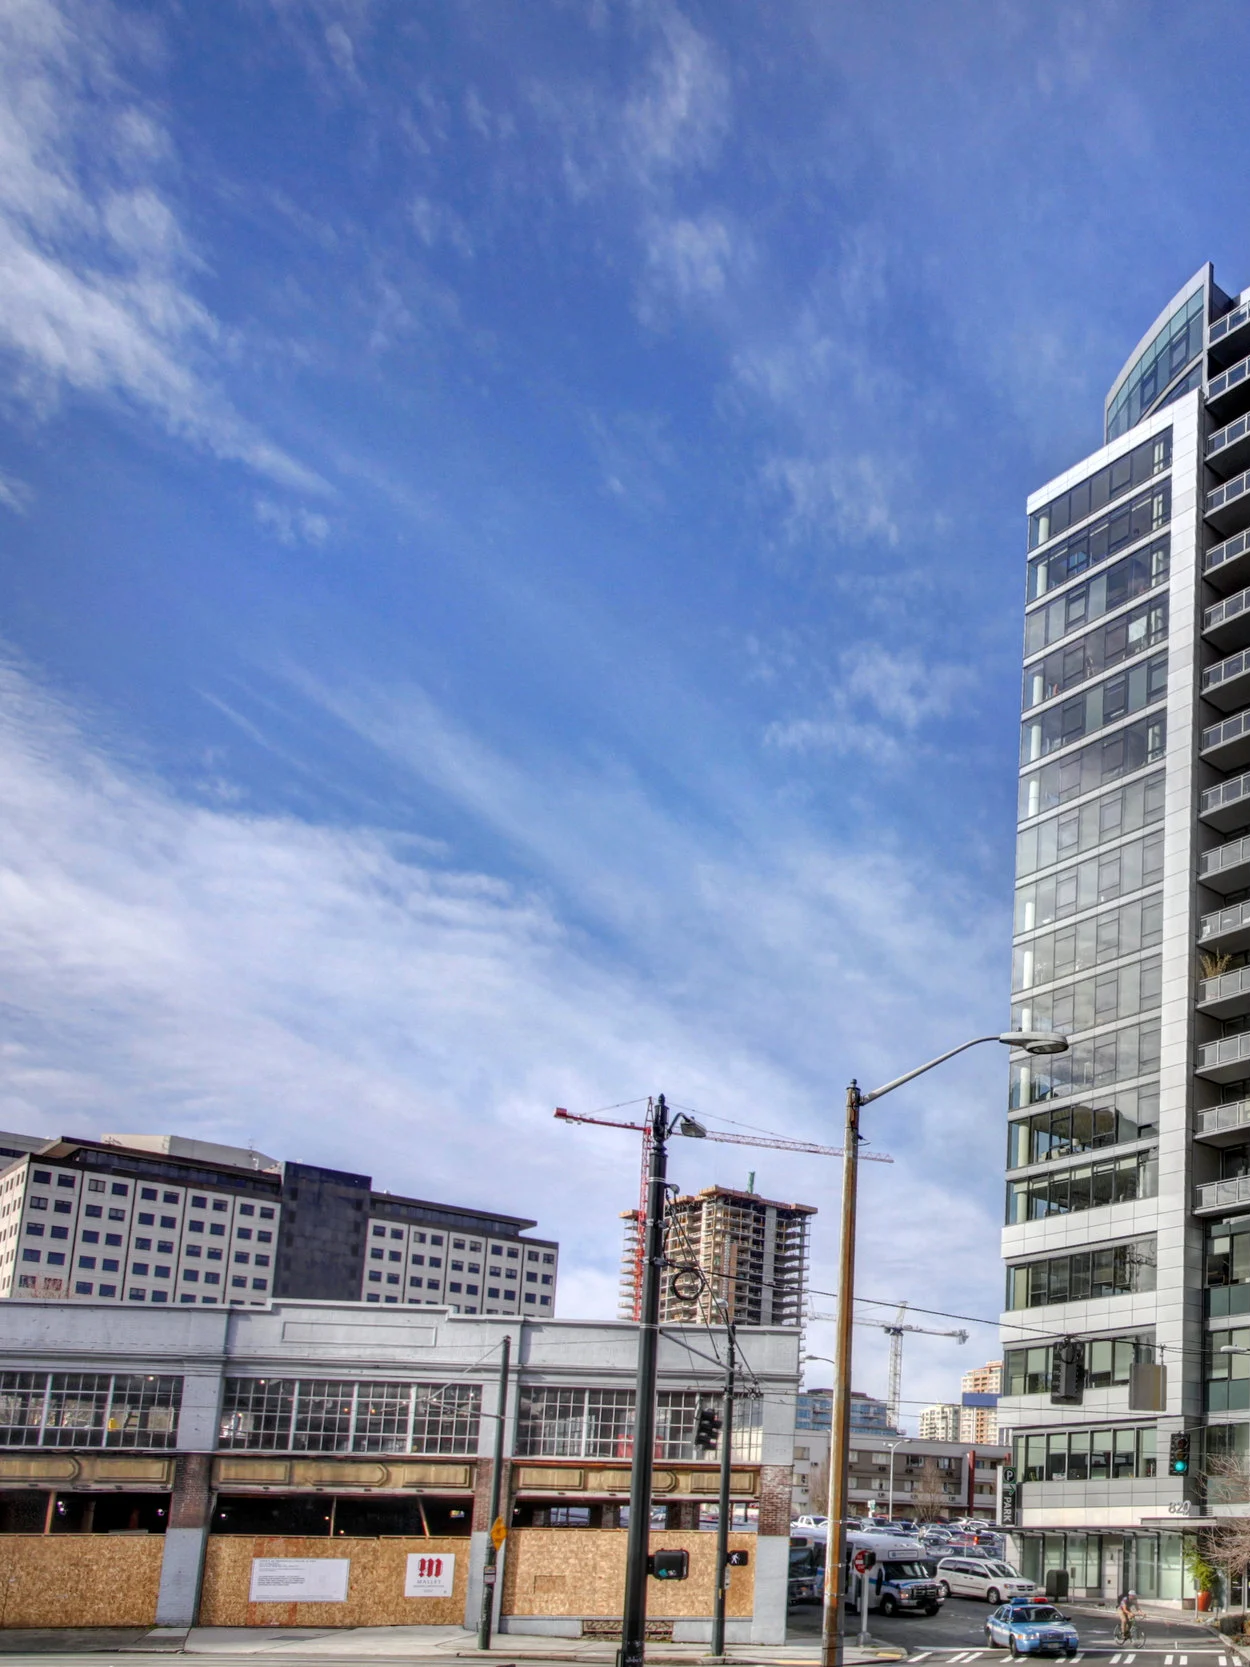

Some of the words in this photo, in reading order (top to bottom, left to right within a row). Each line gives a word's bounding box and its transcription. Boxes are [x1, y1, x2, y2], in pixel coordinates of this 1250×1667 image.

[1006, 1470, 1014, 1481] P
[1003, 1496, 1012, 1522] PARK
[1168, 1500, 1192, 1514] 820
